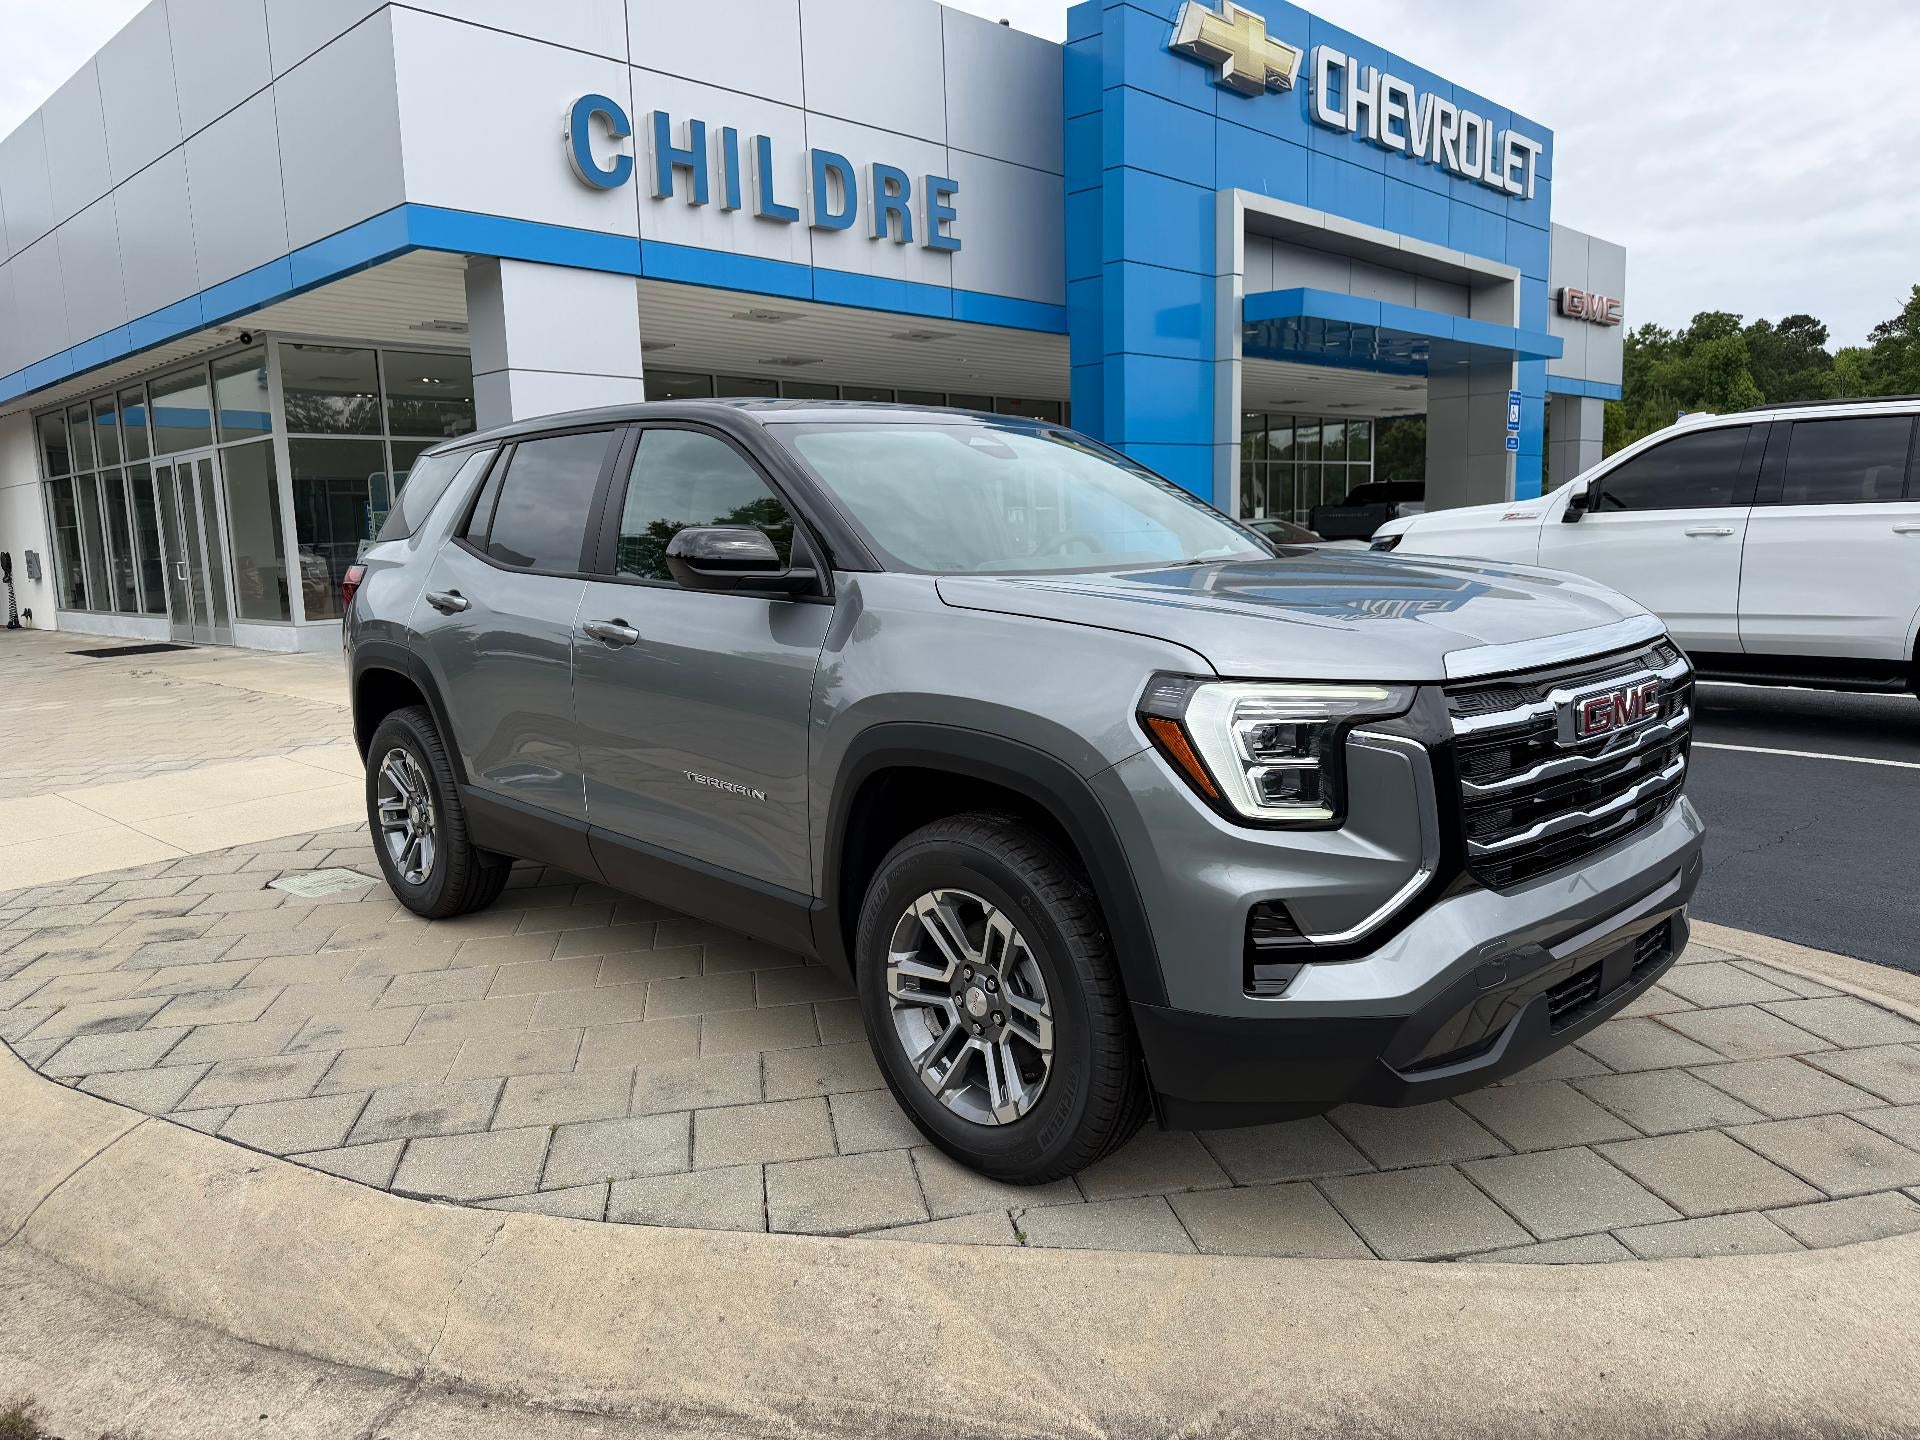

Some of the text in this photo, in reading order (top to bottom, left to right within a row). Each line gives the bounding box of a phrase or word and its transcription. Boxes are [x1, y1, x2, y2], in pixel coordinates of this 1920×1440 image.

[1311, 44, 1543, 200] CHEVROLET
[565, 93, 962, 252] CHILDRE
[1562, 286, 1623, 327] GMC
[1577, 680, 1661, 736] GMC
[682, 769, 768, 802] TERRAIN
